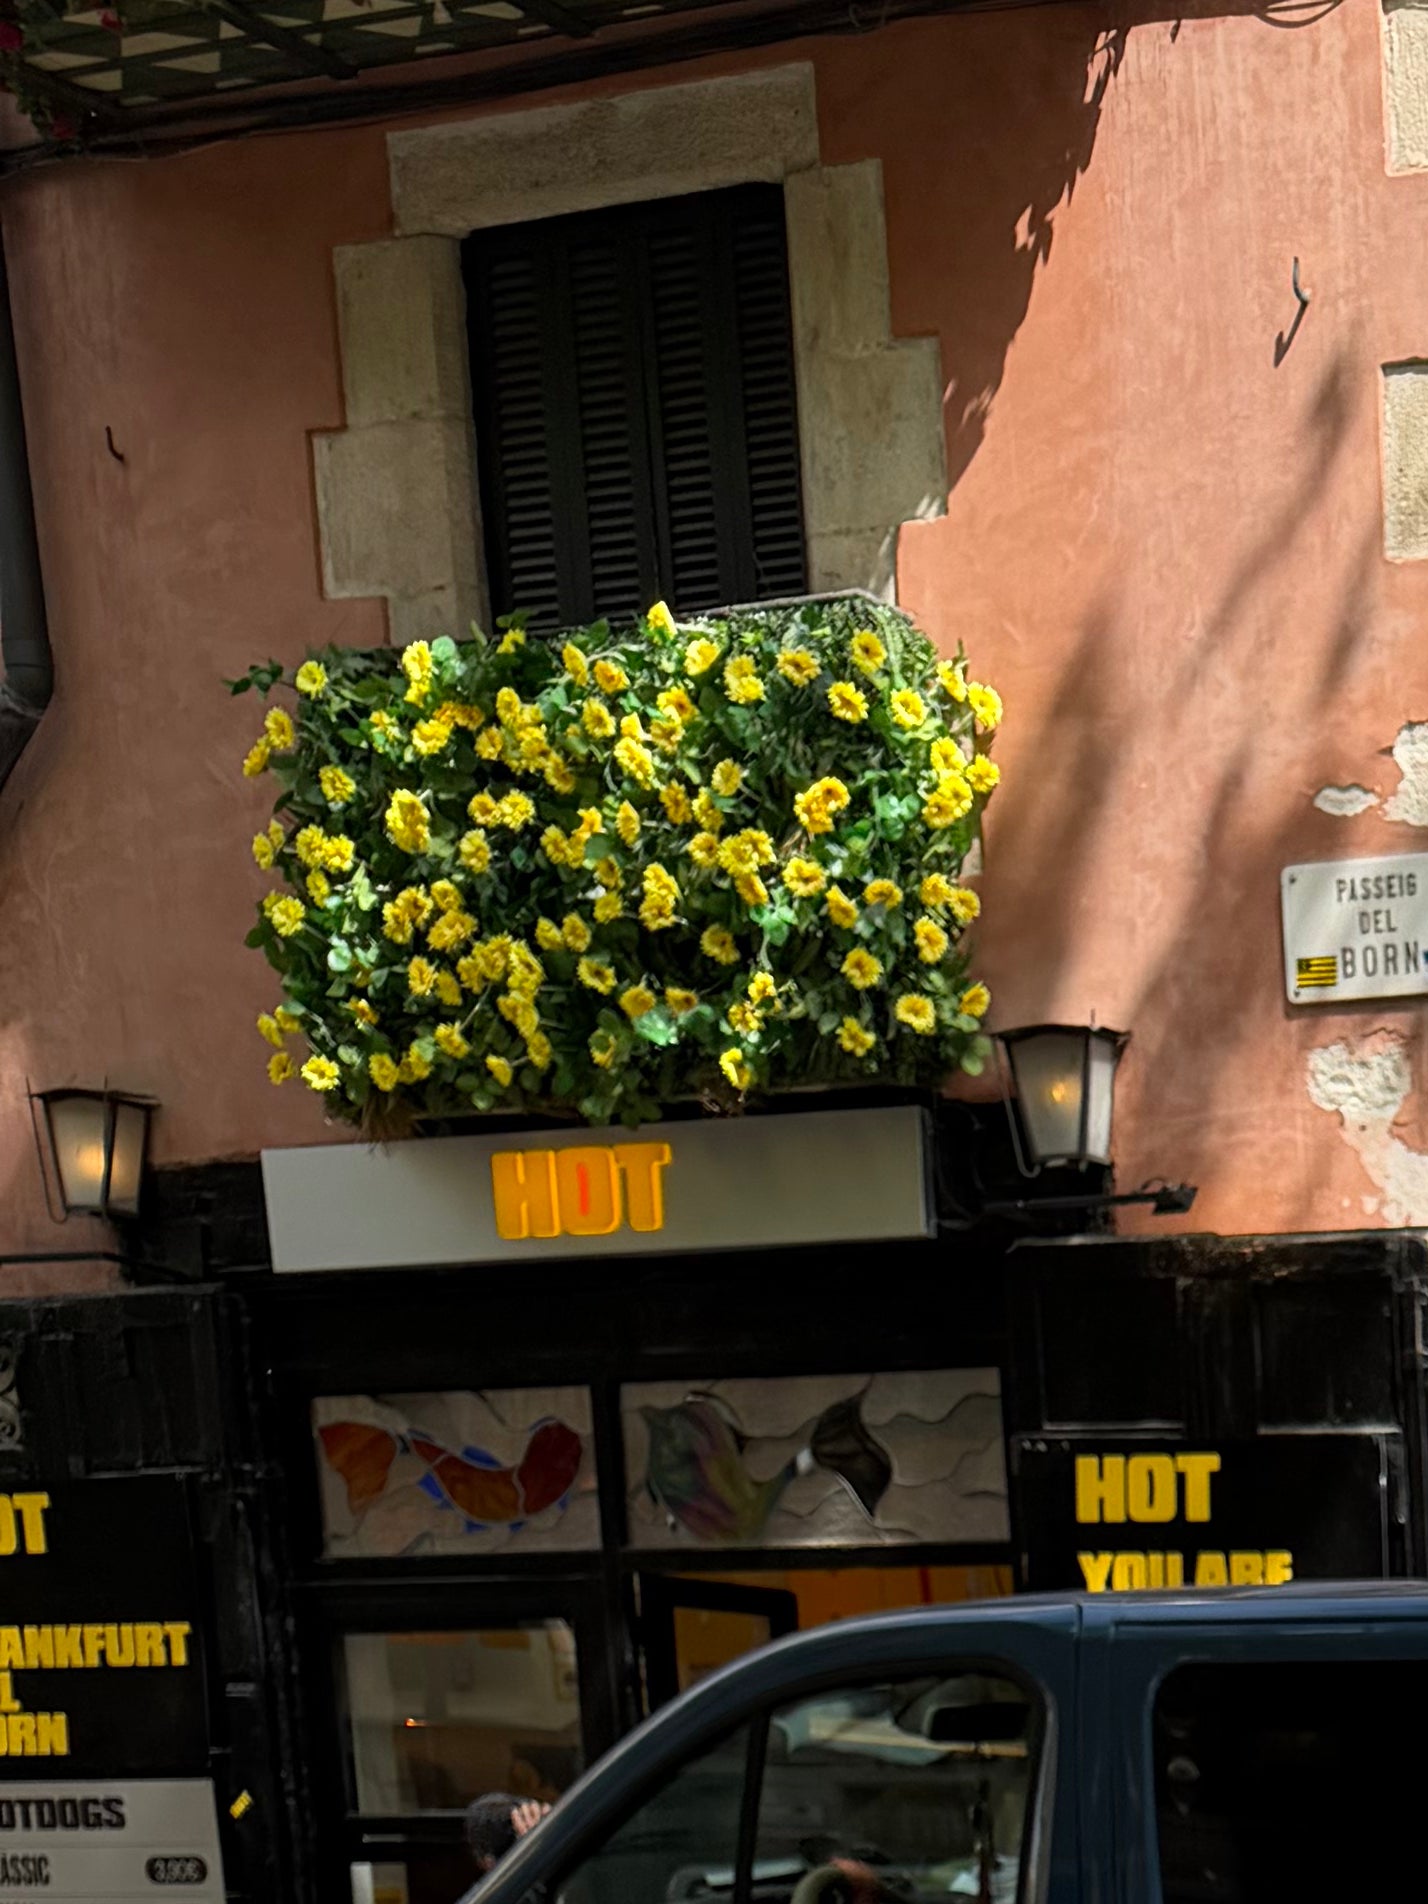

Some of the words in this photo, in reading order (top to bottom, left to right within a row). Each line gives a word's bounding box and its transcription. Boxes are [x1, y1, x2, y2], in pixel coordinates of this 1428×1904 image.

[1335, 873, 1418, 903] PASSEIG
[1358, 909, 1398, 935] DEL
[1341, 941, 1419, 979] BORN
[491, 1142, 672, 1240] HOT
[1075, 1451, 1221, 1523] HOT
[1078, 1550, 1184, 1593] YOU
[1195, 1550, 1294, 1587] ARE
